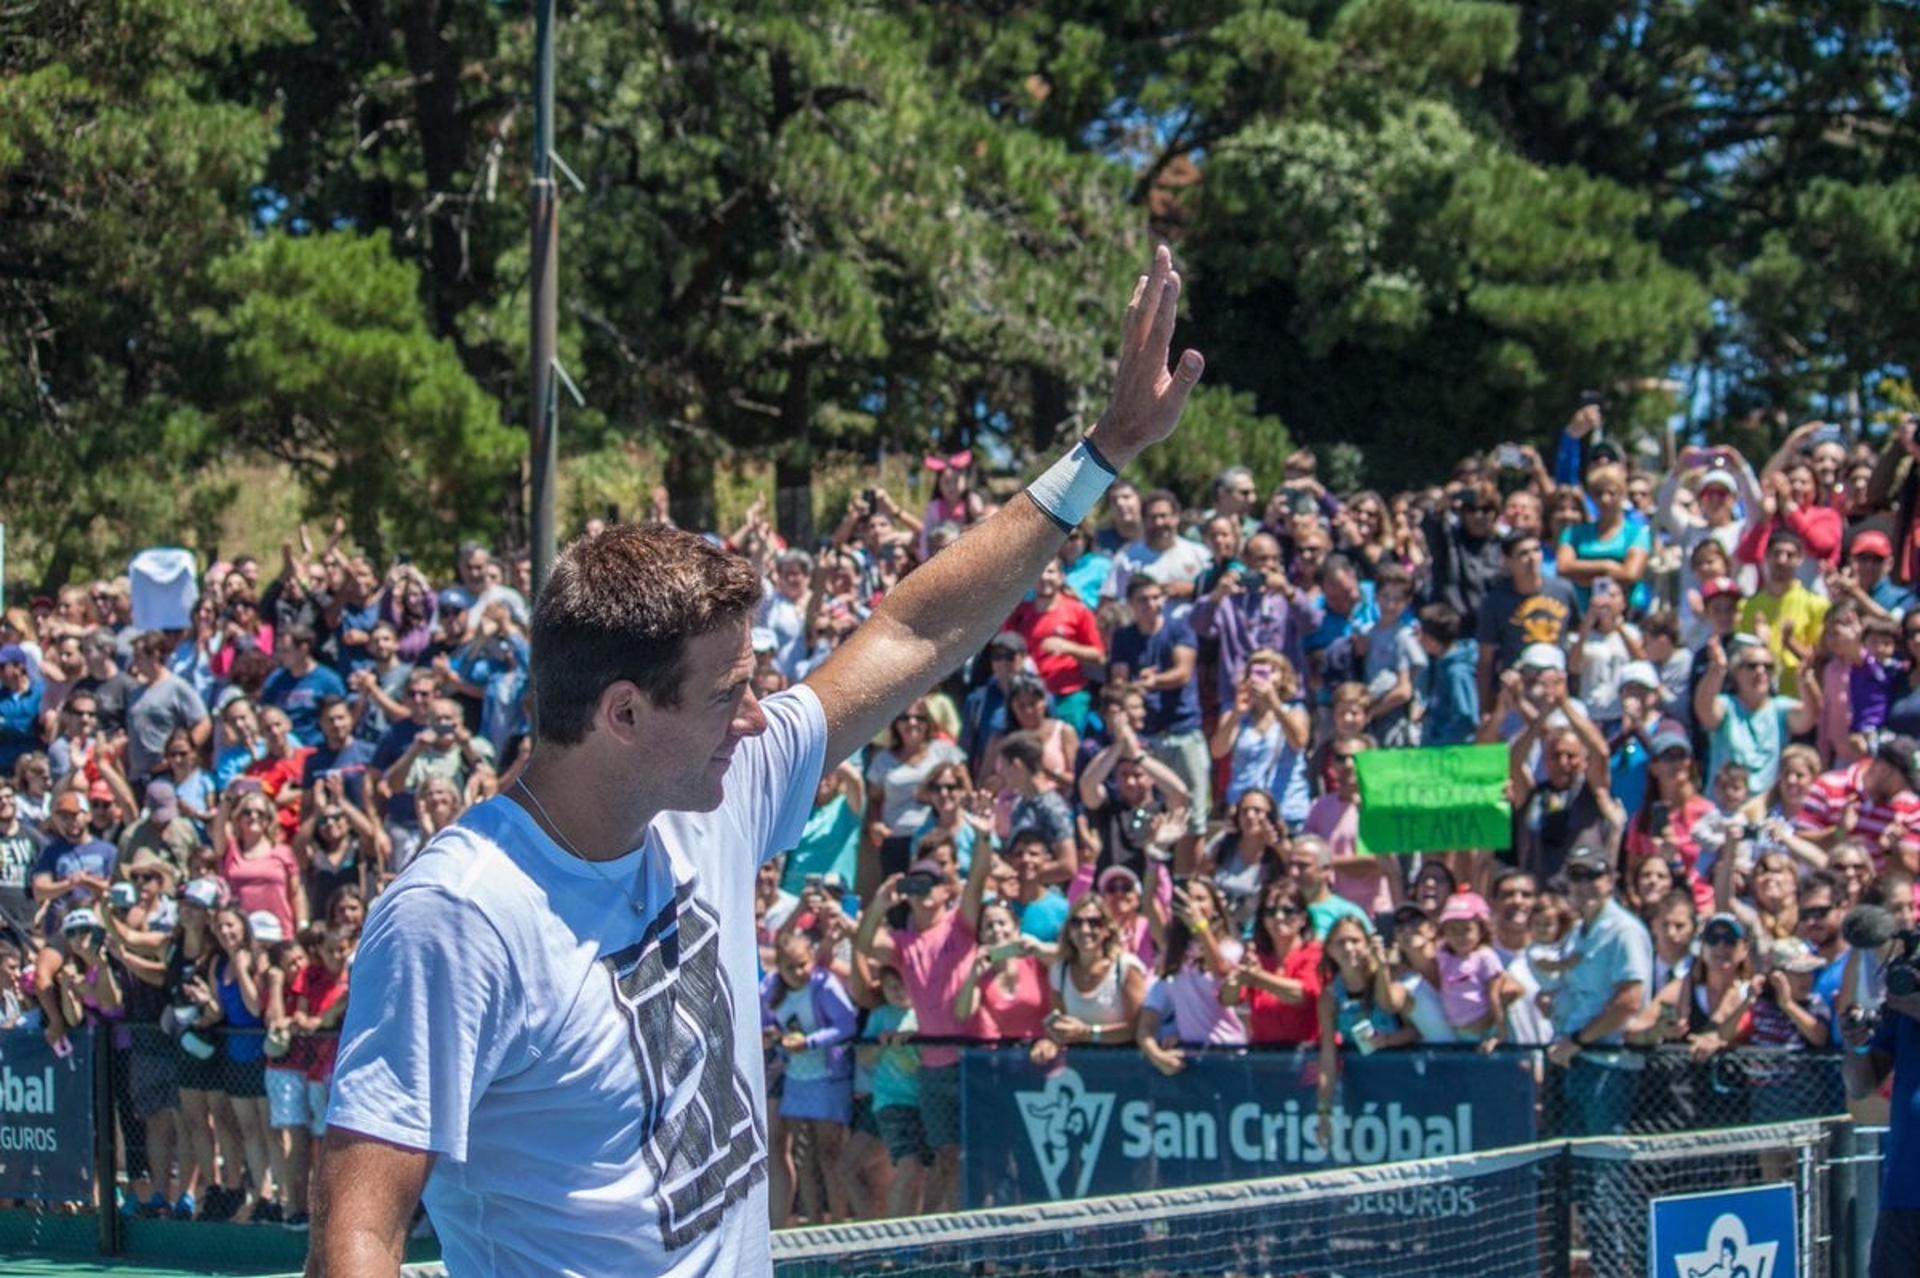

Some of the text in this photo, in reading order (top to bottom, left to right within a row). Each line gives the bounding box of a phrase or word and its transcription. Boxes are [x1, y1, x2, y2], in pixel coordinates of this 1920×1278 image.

[0, 1066, 54, 1113] bal
[1121, 1099, 1473, 1165] San Cristóbal
